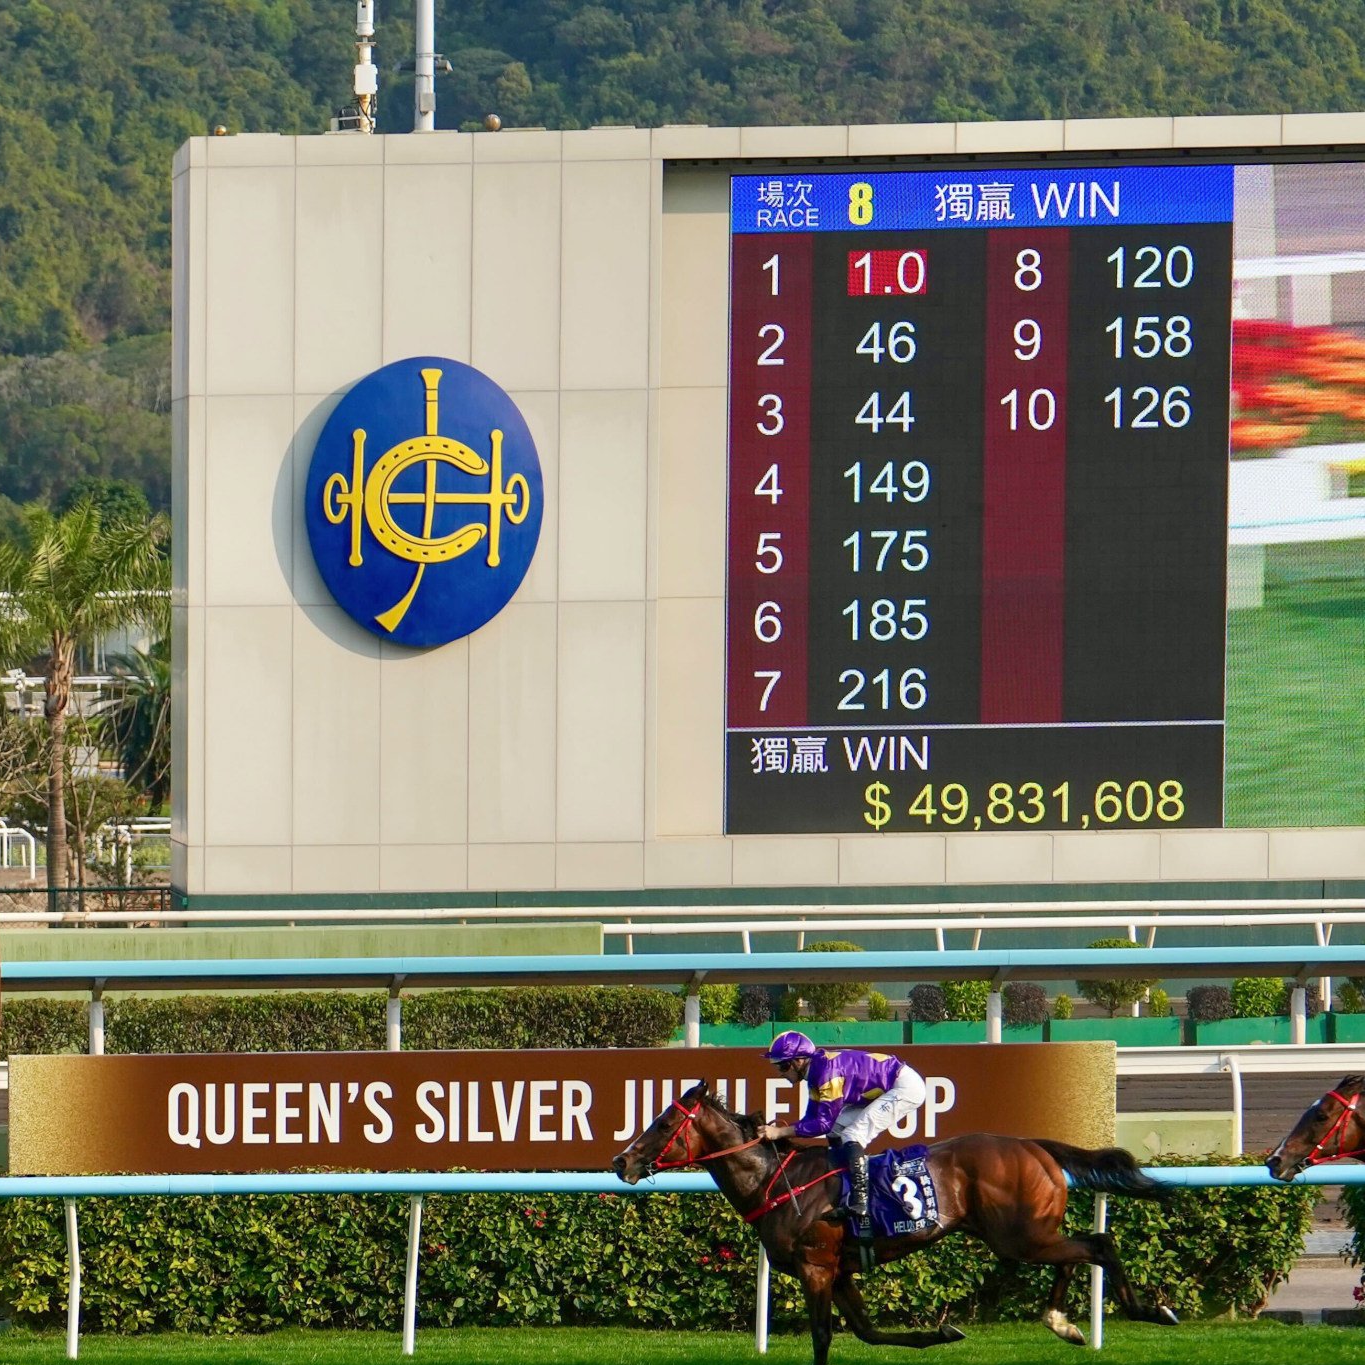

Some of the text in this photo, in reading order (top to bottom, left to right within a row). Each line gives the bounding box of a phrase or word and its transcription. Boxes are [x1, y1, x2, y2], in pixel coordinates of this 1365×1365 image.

[757, 180, 813, 208] 場次
[757, 182, 873, 228] RACE 8
[934, 181, 1121, 222] 獨贏 WIN
[763, 246, 1194, 297] 1 1.0 8 120
[757, 316, 1193, 365] 2 46 9 158
[757, 386, 1191, 435] 3 44 10 126
[755, 461, 930, 504] 4 149
[756, 530, 929, 573] 5 175
[755, 599, 928, 642] 6 185
[754, 668, 927, 711] 7 216
[750, 735, 930, 774] 獨贏 WIN
[864, 779, 1185, 831] $ 49,831,608
[168, 1081, 393, 1148] QUEEN'S
[415, 1080, 594, 1143] SILVER
[891, 1176, 923, 1220] 3
